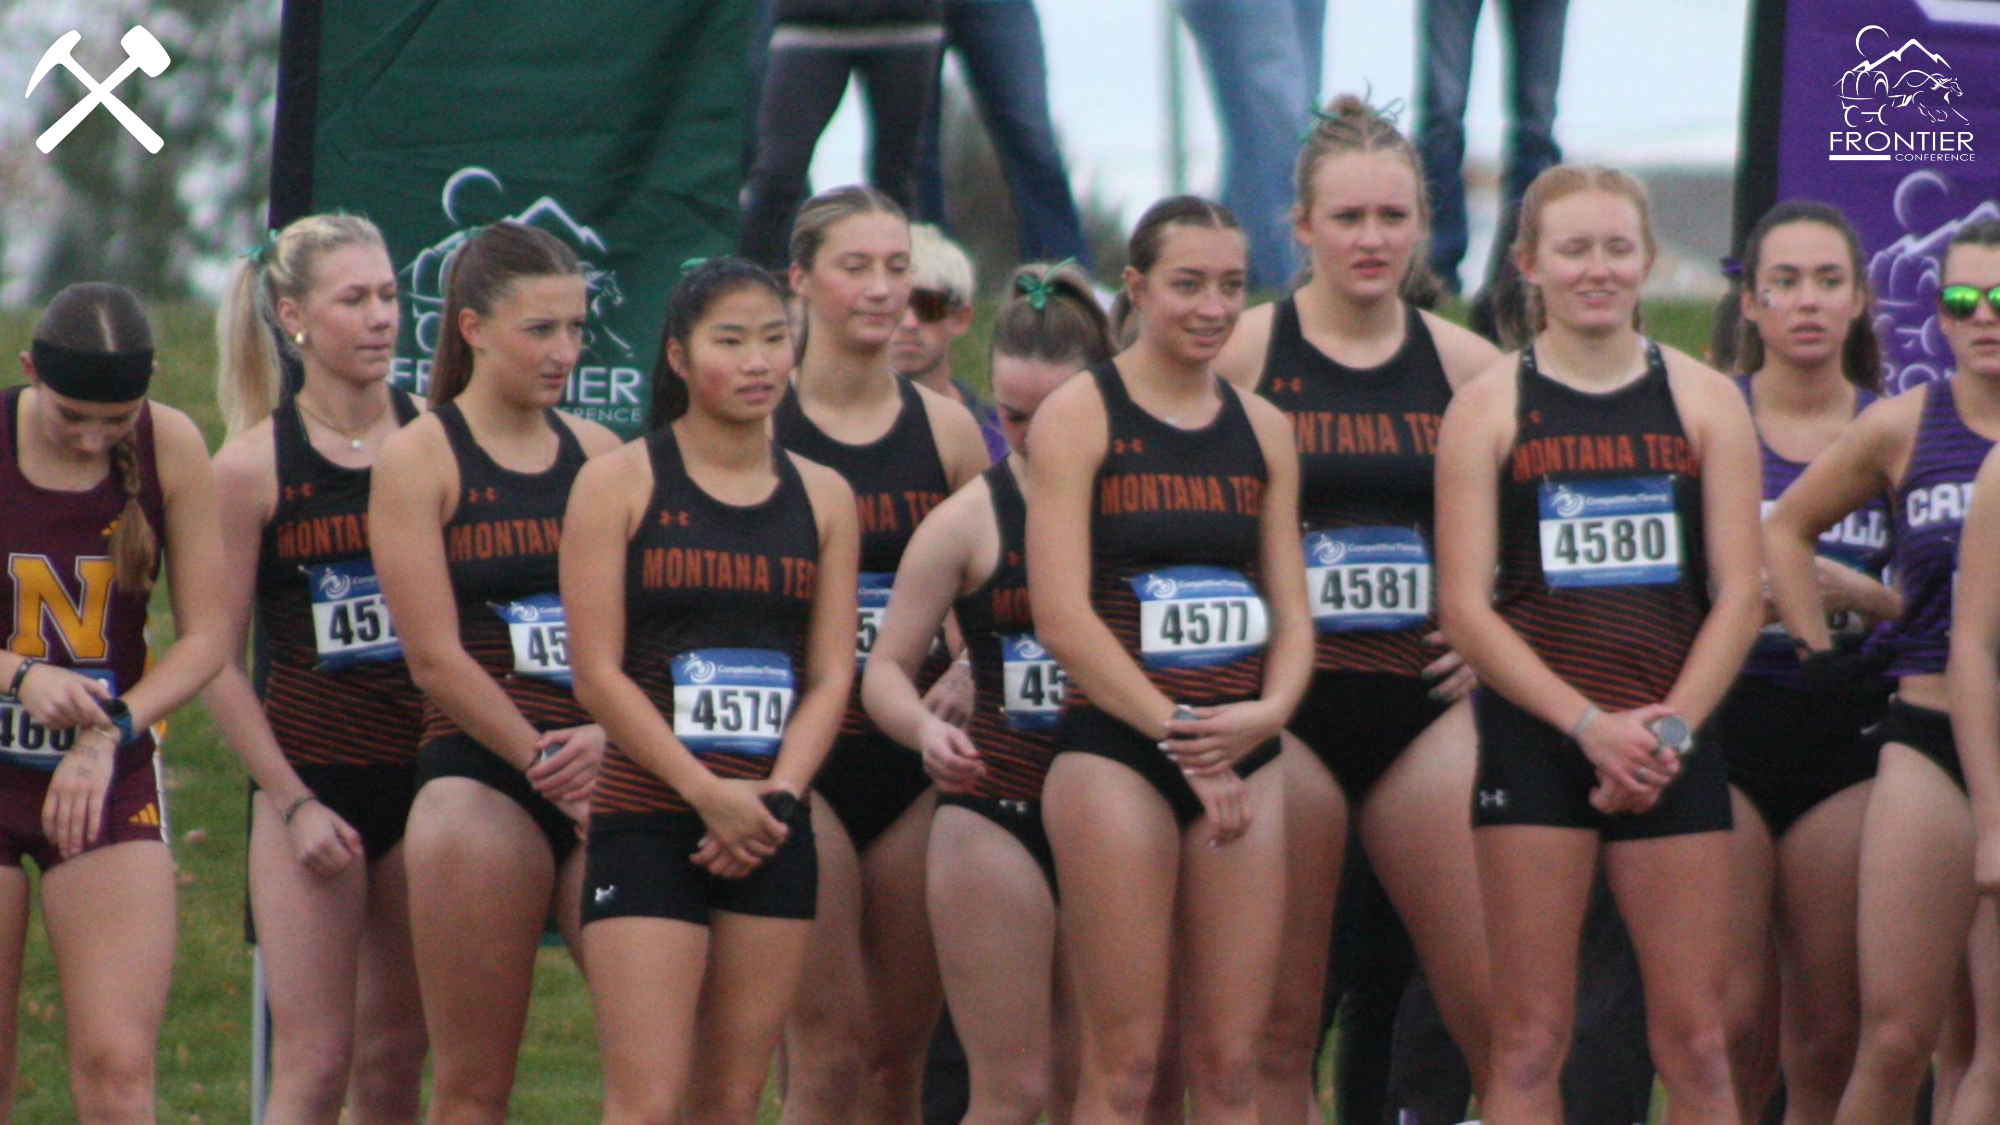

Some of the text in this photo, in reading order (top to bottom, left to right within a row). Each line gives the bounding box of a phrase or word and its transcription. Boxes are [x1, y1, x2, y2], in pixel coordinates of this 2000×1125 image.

[388, 357, 643, 405] FRIER
[1285, 411, 1443, 456] NTANA TE
[1513, 434, 1637, 483] MONTANA
[1101, 472, 1227, 515] MONTANA
[277, 512, 369, 558] MONTA
[450, 516, 564, 562] MONTAN
[1554, 517, 1666, 565] 4580
[642, 546, 771, 593] MONTANA
[1320, 566, 1417, 610] 4581
[8, 553, 116, 662] N
[329, 597, 392, 646] 45
[1160, 601, 1249, 646] 4577
[527, 625, 571, 667] 45
[691, 688, 783, 734] 4574
